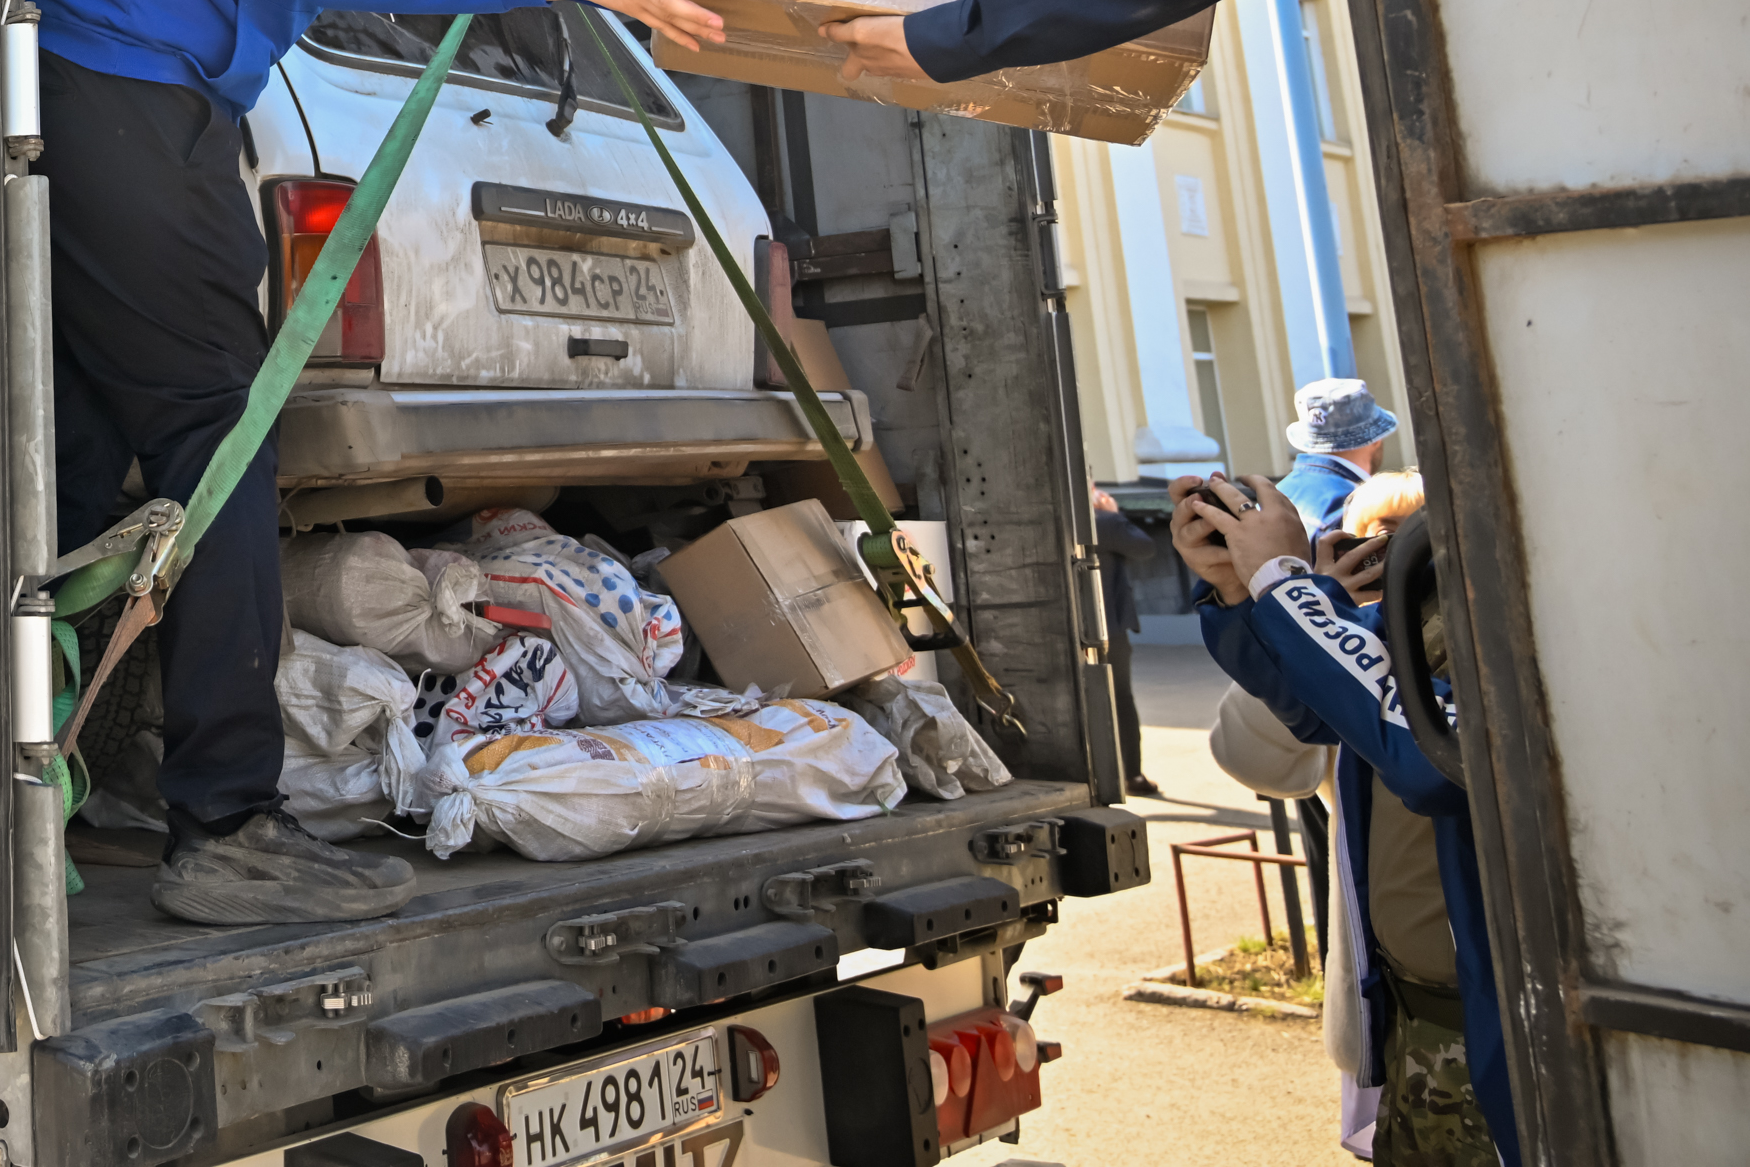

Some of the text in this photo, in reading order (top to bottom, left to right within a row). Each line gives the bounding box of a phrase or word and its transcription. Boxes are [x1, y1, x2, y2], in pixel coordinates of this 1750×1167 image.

[545, 198, 649, 231] LADA 4x4
[629, 265, 659, 304] 24
[634, 301, 655, 316] RUS
[1285, 586, 1385, 672] РОССИЯ
[524, 1102, 570, 1167] НК
[579, 1059, 668, 1143] 4981
[672, 1045, 707, 1097] 24
[673, 1095, 698, 1118] RUS
